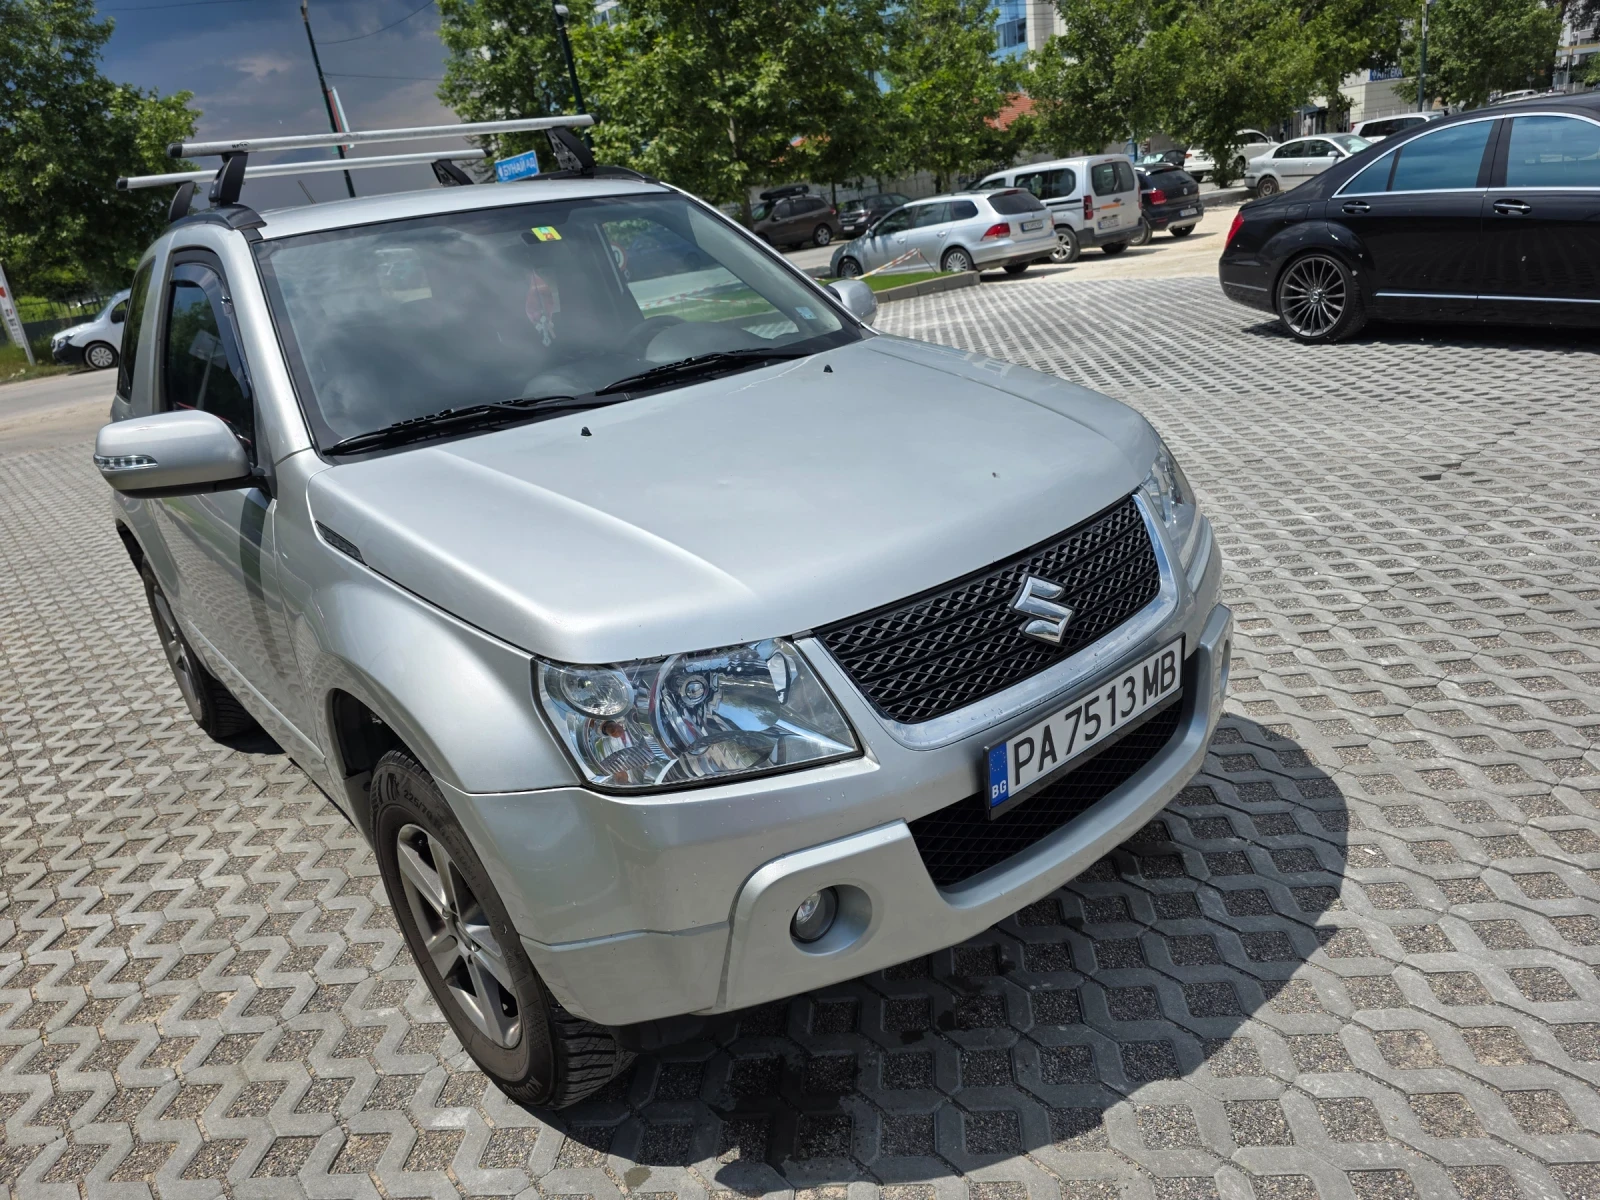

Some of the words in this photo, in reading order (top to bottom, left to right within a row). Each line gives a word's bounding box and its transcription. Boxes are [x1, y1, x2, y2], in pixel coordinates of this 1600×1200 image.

[1013, 725, 1058, 786] PA
[1065, 676, 1137, 755] 7513
[1142, 650, 1177, 706] MB
[992, 779, 1007, 799] BG
[403, 789, 433, 819] 225/70
[502, 1076, 543, 1099] KUMHO
